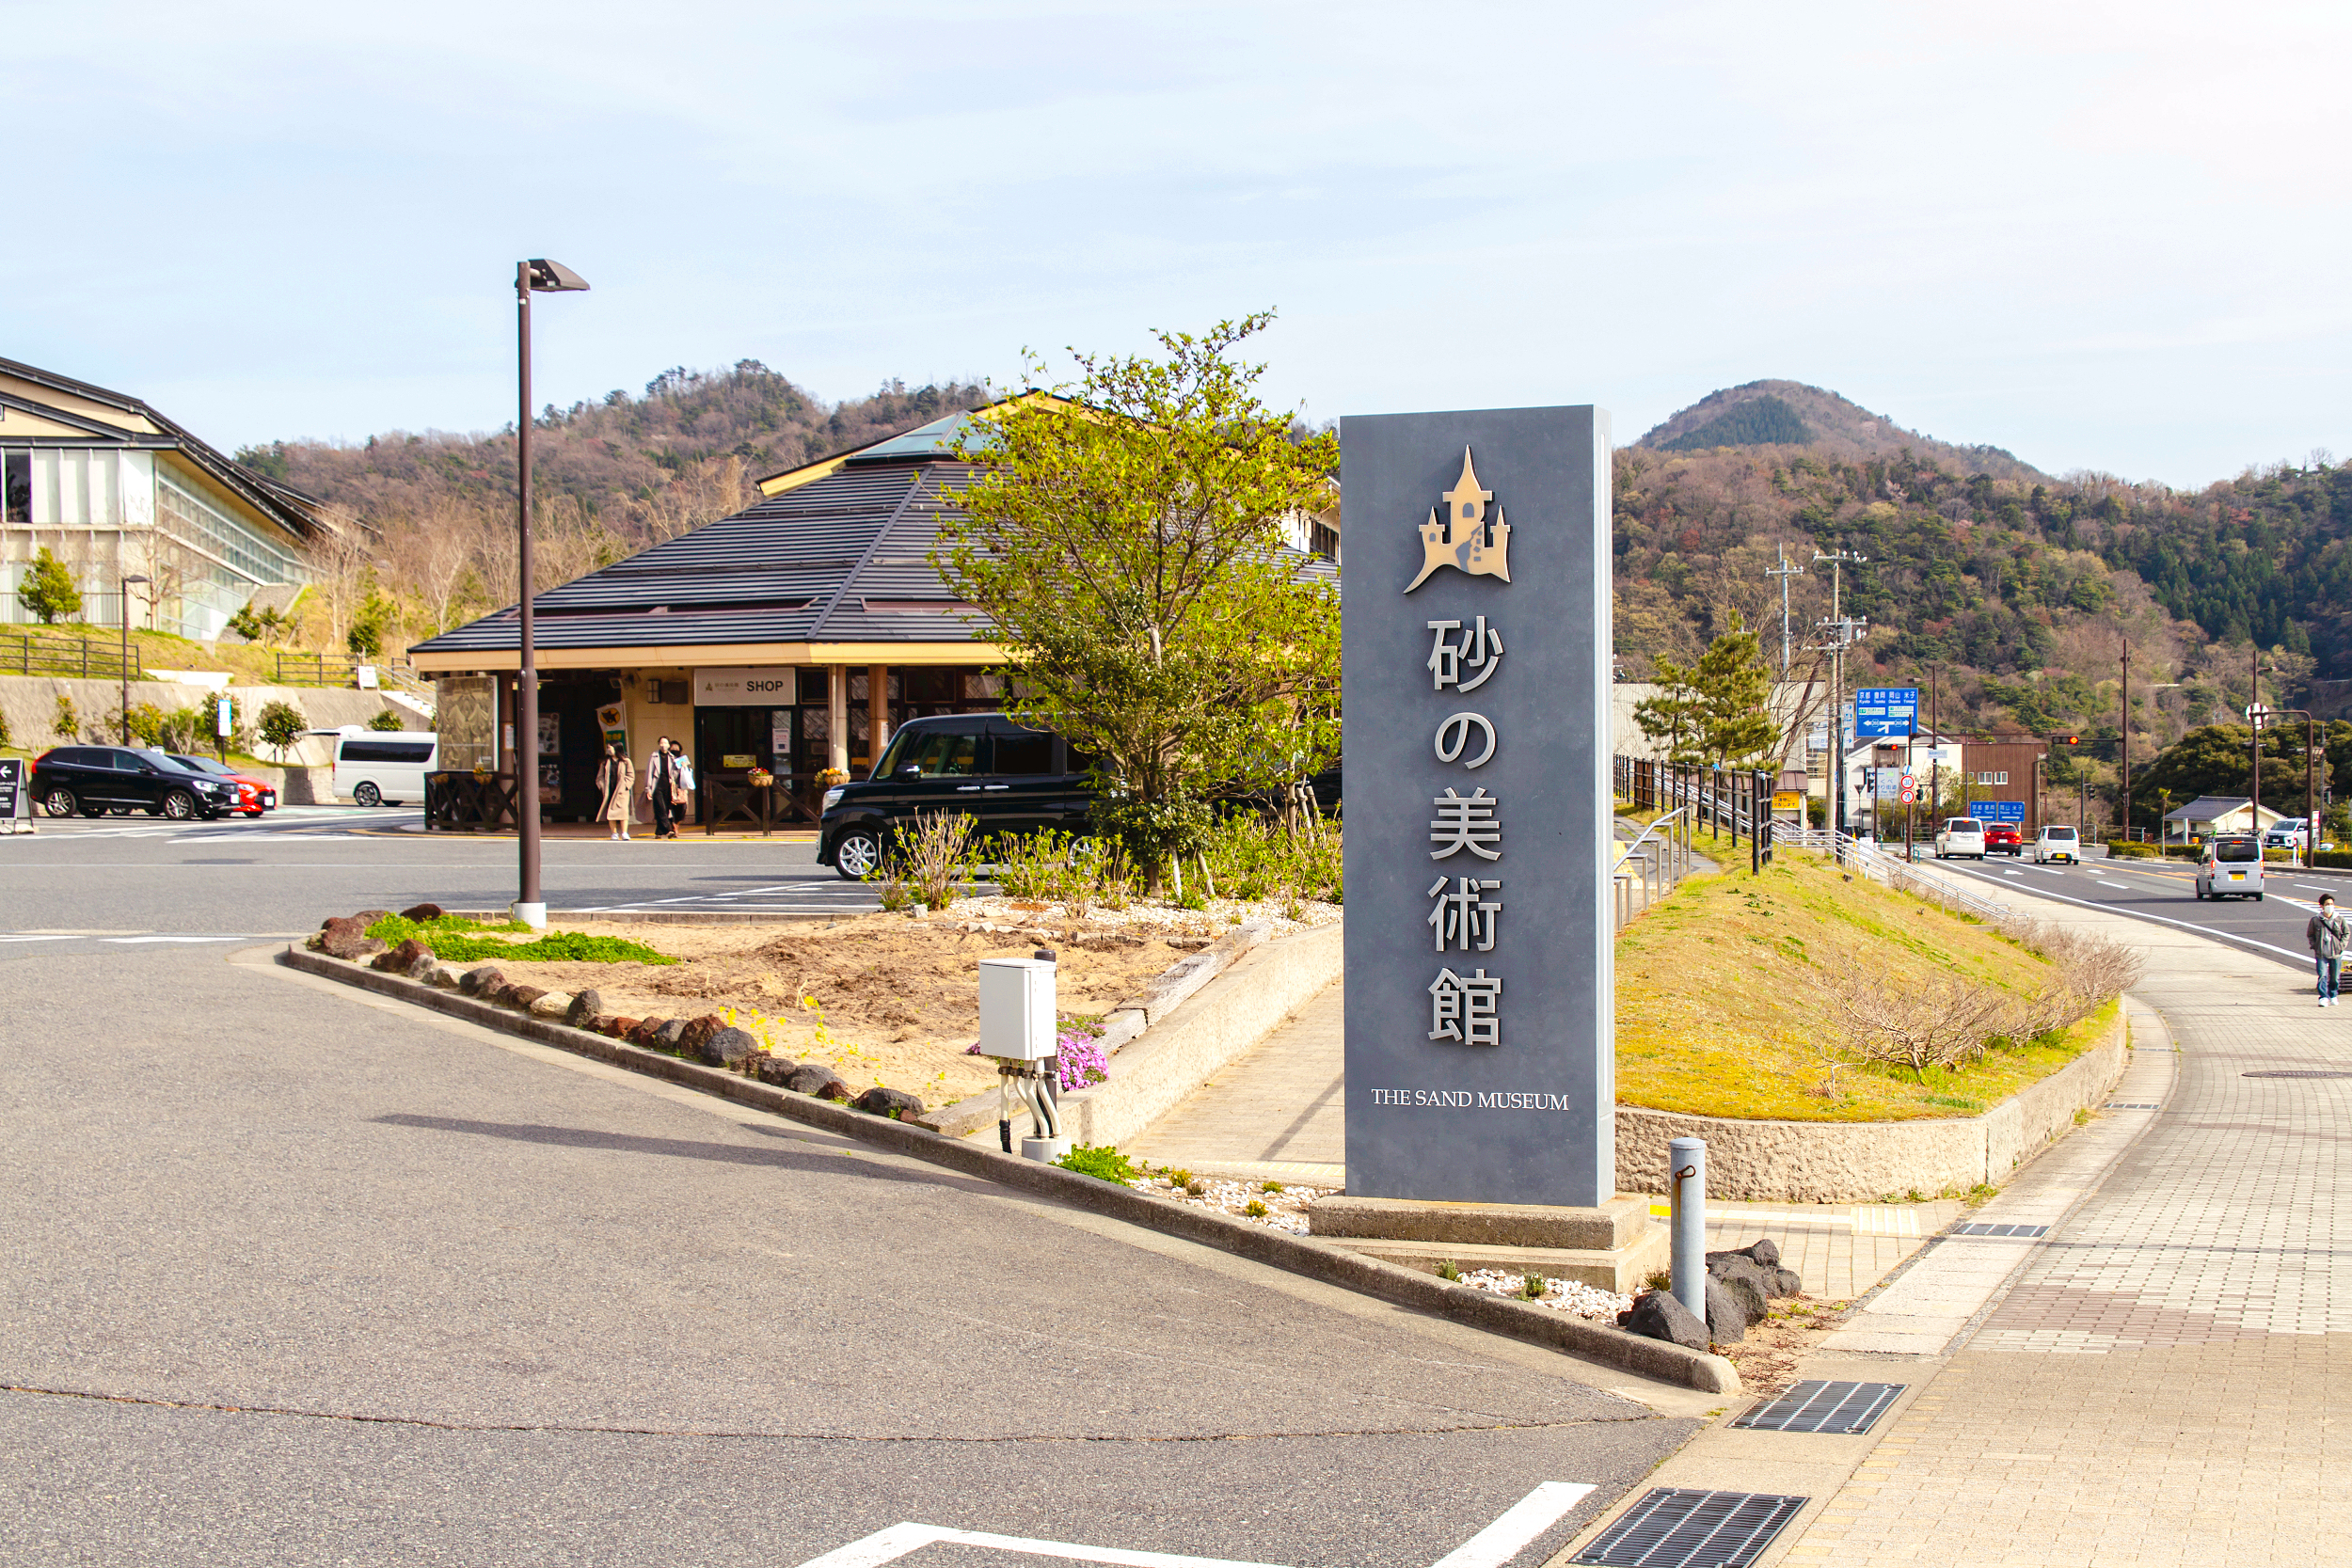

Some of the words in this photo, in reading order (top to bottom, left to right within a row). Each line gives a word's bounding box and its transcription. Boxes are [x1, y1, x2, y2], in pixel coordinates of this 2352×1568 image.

[746, 680, 784, 691] SHOP
[1426, 614, 1505, 1045] 砂の美術館
[1371, 1088, 1411, 1105] THE
[1415, 1089, 1472, 1107] SAND
[1477, 1091, 1569, 1111] MUSEUM
